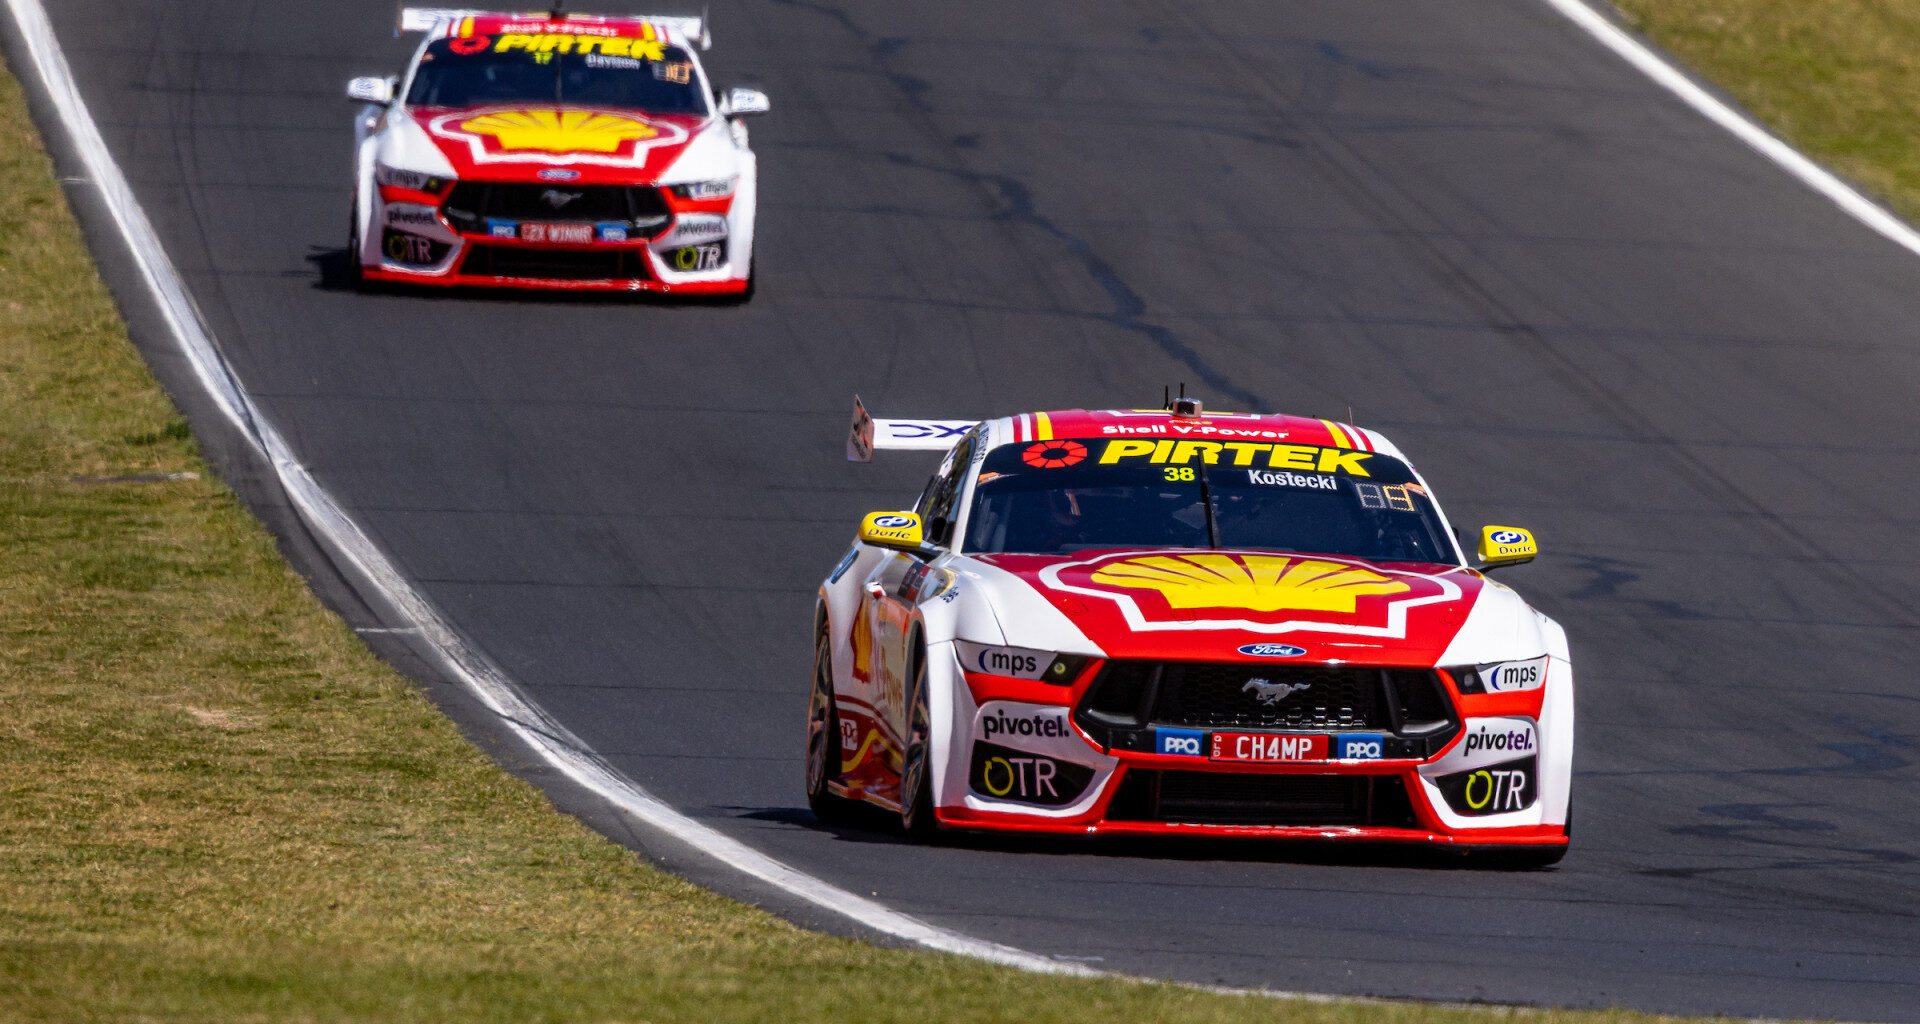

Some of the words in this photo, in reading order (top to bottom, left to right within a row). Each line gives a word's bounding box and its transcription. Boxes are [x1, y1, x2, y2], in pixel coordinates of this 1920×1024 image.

[494, 33, 665, 61] PIRTEK
[388, 235, 432, 263] OTR
[676, 245, 721, 269] OTR
[1103, 425, 1166, 434] Shell
[1173, 426, 1289, 438] V-Power
[1099, 440, 1373, 477] PIRTEK
[1164, 467, 1195, 482] 38
[1248, 469, 1337, 491] Kostecki
[868, 529, 911, 539] Doric
[1499, 546, 1534, 554] Doric
[1251, 643, 1294, 655] Ford
[992, 653, 1037, 675] mps
[1504, 666, 1537, 687] mps
[983, 709, 1069, 739] pivotel.
[1165, 737, 1200, 754] PPQ
[1236, 736, 1312, 760] CH4MP
[1346, 742, 1381, 758] PPQ
[1464, 725, 1533, 756] pivotel.
[984, 757, 1059, 797] OTR
[1466, 770, 1526, 810] OTR
